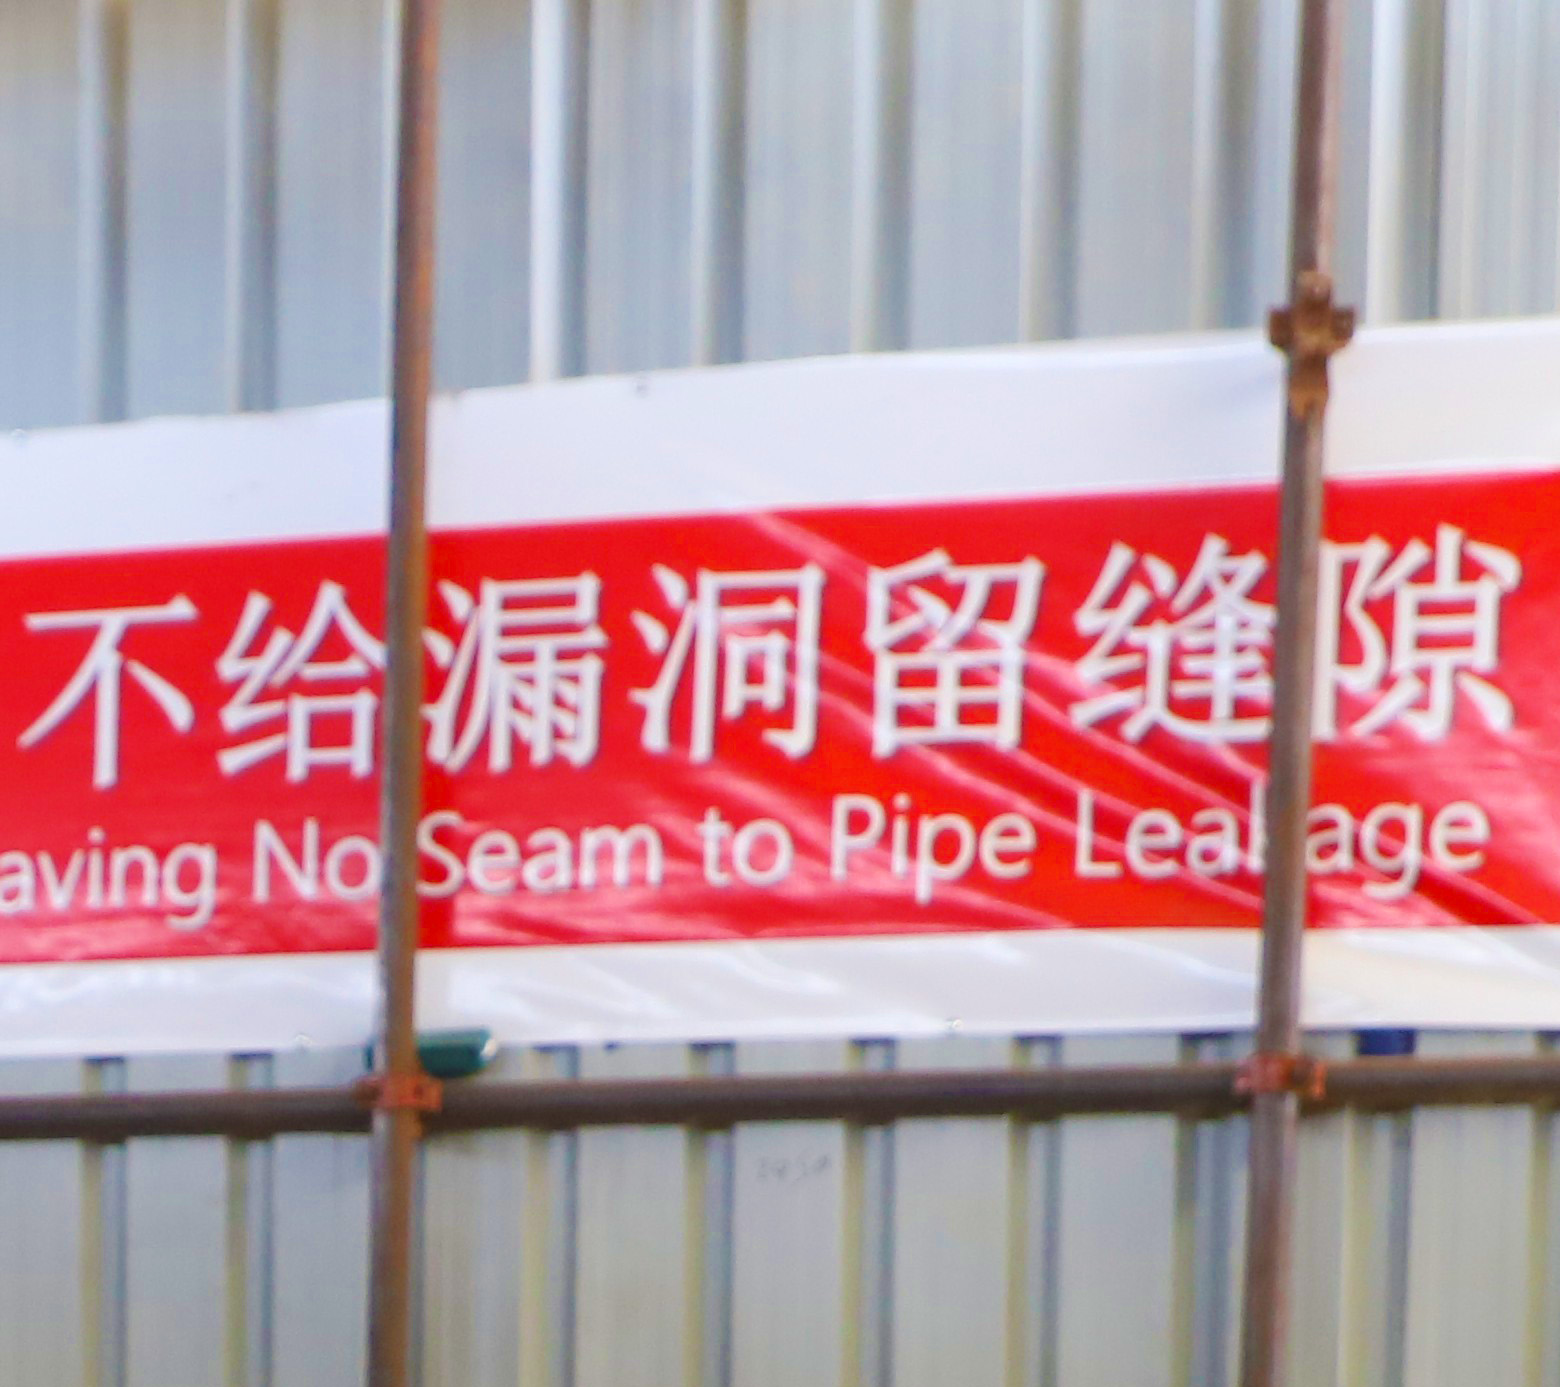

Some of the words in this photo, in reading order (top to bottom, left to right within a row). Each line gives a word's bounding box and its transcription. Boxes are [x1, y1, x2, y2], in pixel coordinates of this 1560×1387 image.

[17, 522, 1523, 789] 不给漏洞留缝隙
[252, 816, 384, 904] No
[415, 810, 664, 897] Seam
[700, 806, 795, 887] to
[829, 793, 1036, 905] Pipe
